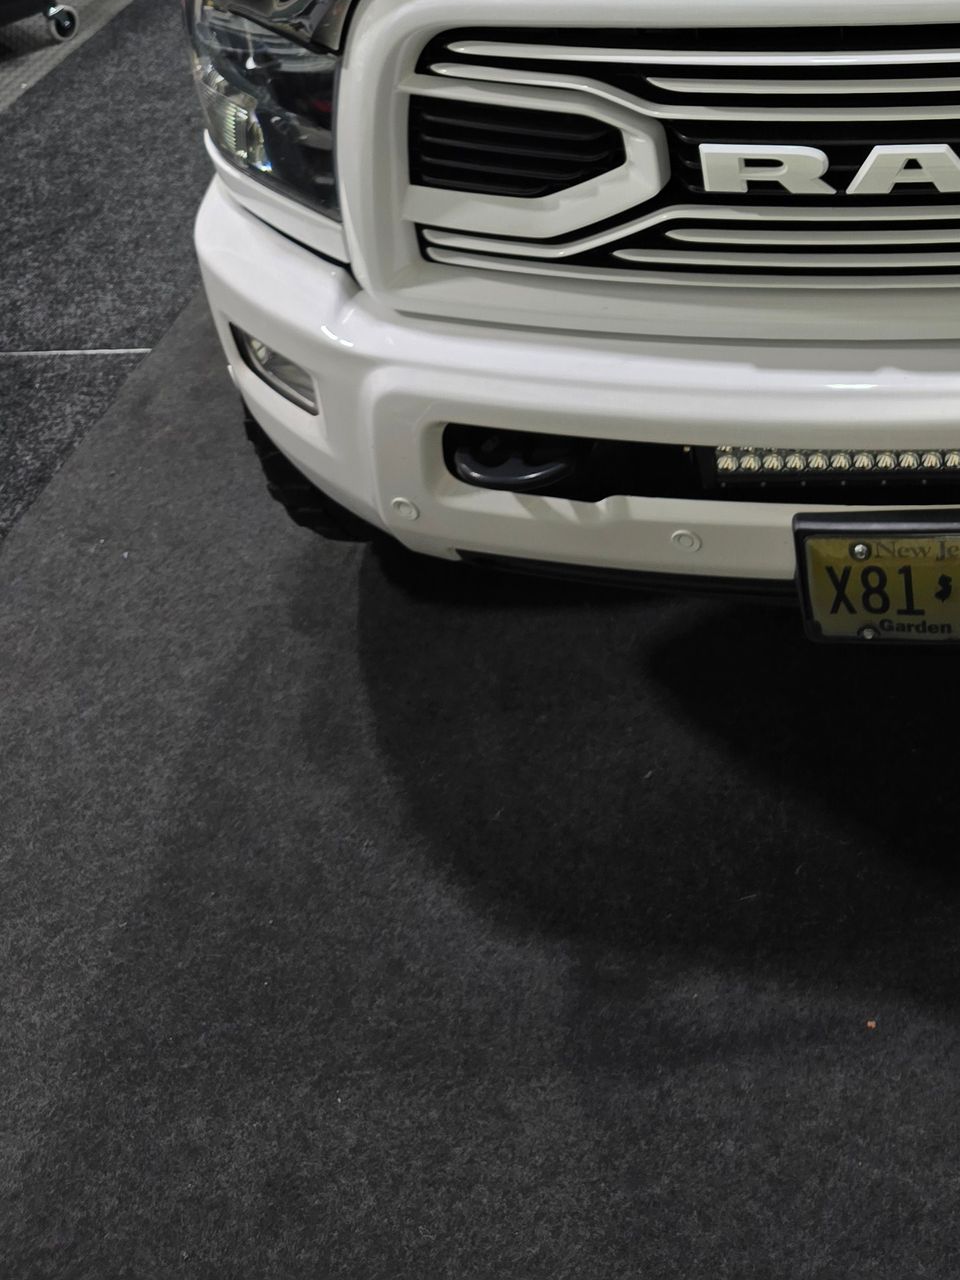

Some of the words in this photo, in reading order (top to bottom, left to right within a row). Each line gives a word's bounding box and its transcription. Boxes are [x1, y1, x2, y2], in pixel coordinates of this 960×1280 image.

[875, 539, 932, 558] New
[826, 565, 925, 616] X81
[879, 619, 951, 634] Garden
